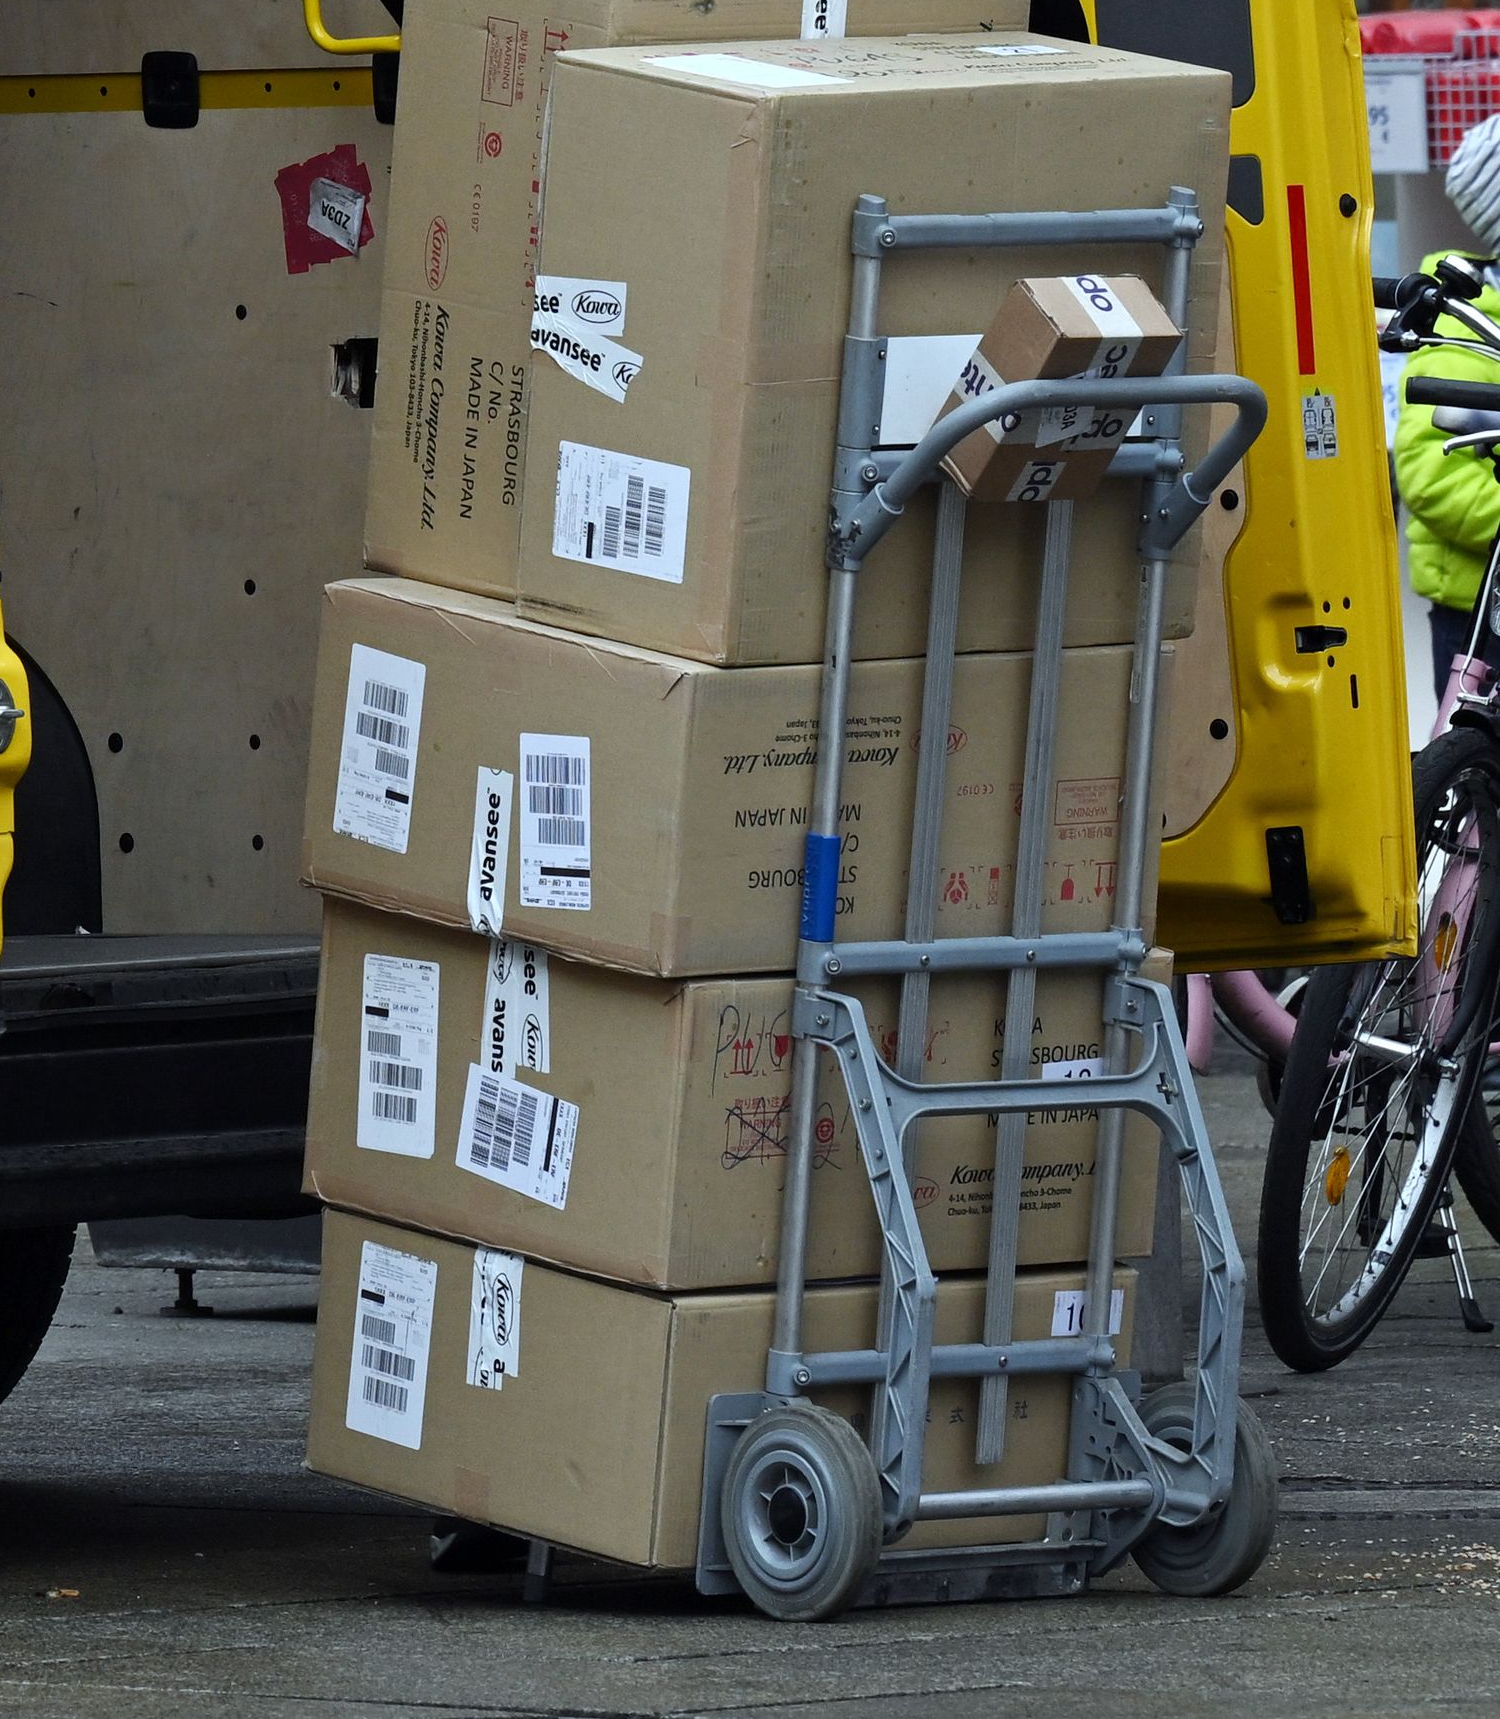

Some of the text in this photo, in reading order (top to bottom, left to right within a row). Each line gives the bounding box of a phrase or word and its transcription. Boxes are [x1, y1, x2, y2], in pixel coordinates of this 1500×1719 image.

[501, 34, 513, 91] WARNING
[320, 199, 352, 231] ZD3A
[429, 218, 447, 287] Kowa
[575, 295, 620, 317] Kowa
[431, 303, 450, 372] Kowa
[530, 327, 602, 372] avansee
[409, 343, 419, 369] Tokyo
[417, 327, 430, 419] Nihonbashi-Honcho
[487, 360, 504, 425] C/ No.
[403, 417, 414, 449] Japan
[412, 420, 423, 464] 3-Chome
[459, 356, 484, 520] MADE IN JAPAN
[502, 364, 524, 507] STRASBOURG
[420, 483, 437, 531] Ltd.
[722, 746, 900, 776] Kowa mpany. Ltd.
[957, 784, 979, 798] 0197
[734, 806, 807, 828] IN JAPAN
[1066, 806, 1109, 819] WARNING
[479, 792, 501, 902] avansee
[841, 834, 860, 855] C/
[748, 864, 858, 889] STBOURG
[993, 1016, 1043, 1037] KA
[991, 1042, 1100, 1069] SSBOURG
[1060, 1106, 1100, 1124] JAPA
[1020, 1160, 1086, 1185] mpany.
[496, 1278, 511, 1344] Kowa
